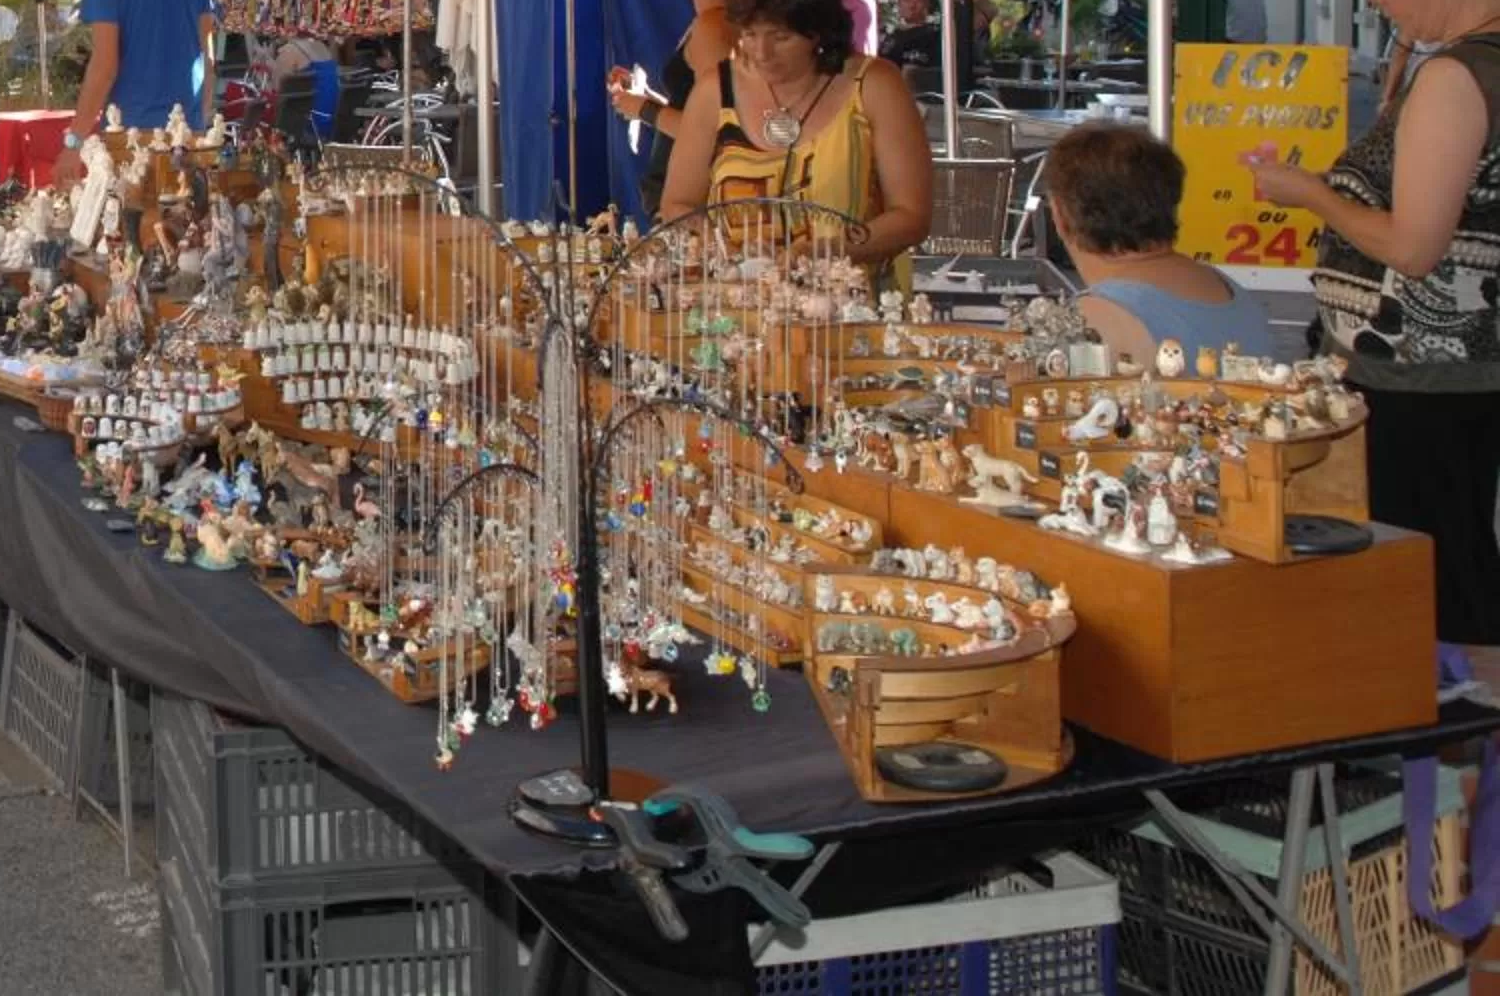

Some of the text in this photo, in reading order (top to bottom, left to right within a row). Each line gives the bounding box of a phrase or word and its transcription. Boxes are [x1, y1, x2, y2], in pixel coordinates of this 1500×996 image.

[1211, 50, 1309, 90] ICI
[1239, 104, 1339, 130] PHOTOS
[1257, 211, 1288, 223] ou
[1225, 223, 1301, 266] 24
